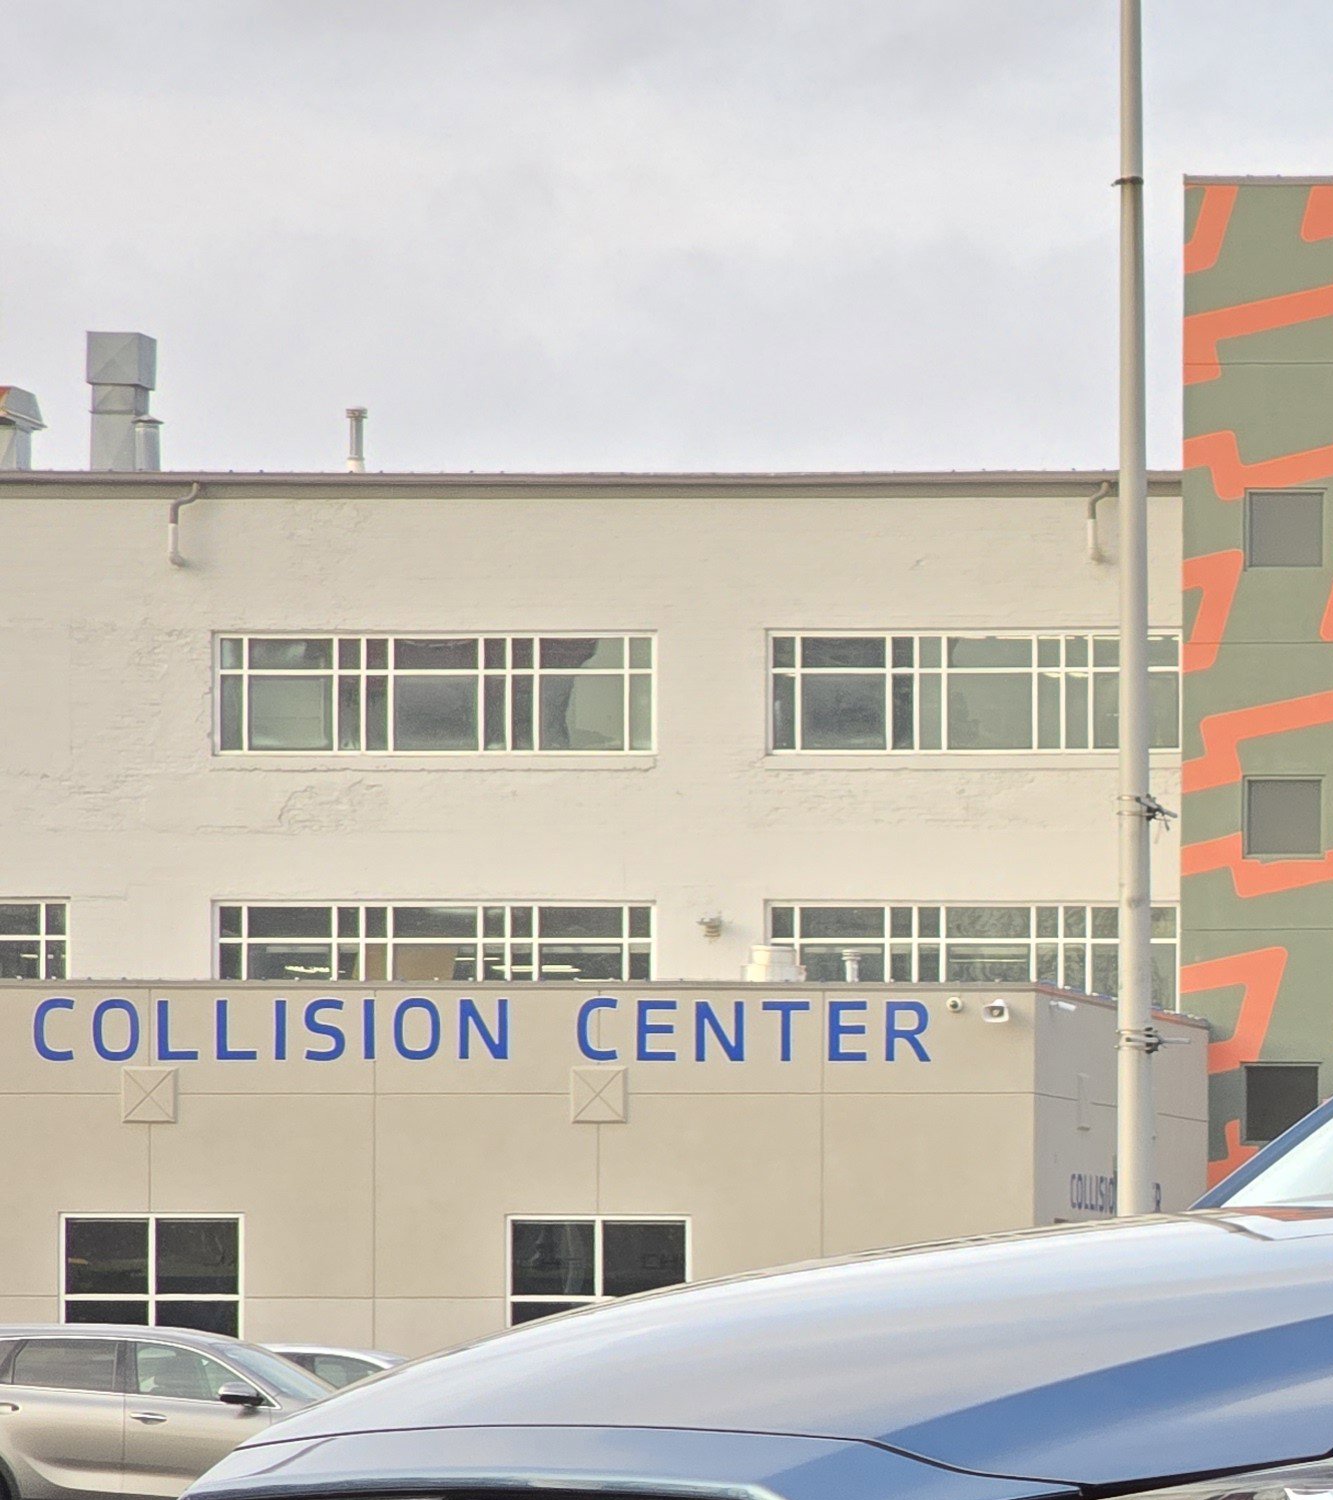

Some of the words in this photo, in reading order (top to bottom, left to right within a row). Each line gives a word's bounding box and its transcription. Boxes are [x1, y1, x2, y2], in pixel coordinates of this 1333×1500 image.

[33, 996, 511, 1062] COLLISION
[576, 996, 933, 1062] CENTER
[1070, 1173, 1117, 1214] COLLISIO
